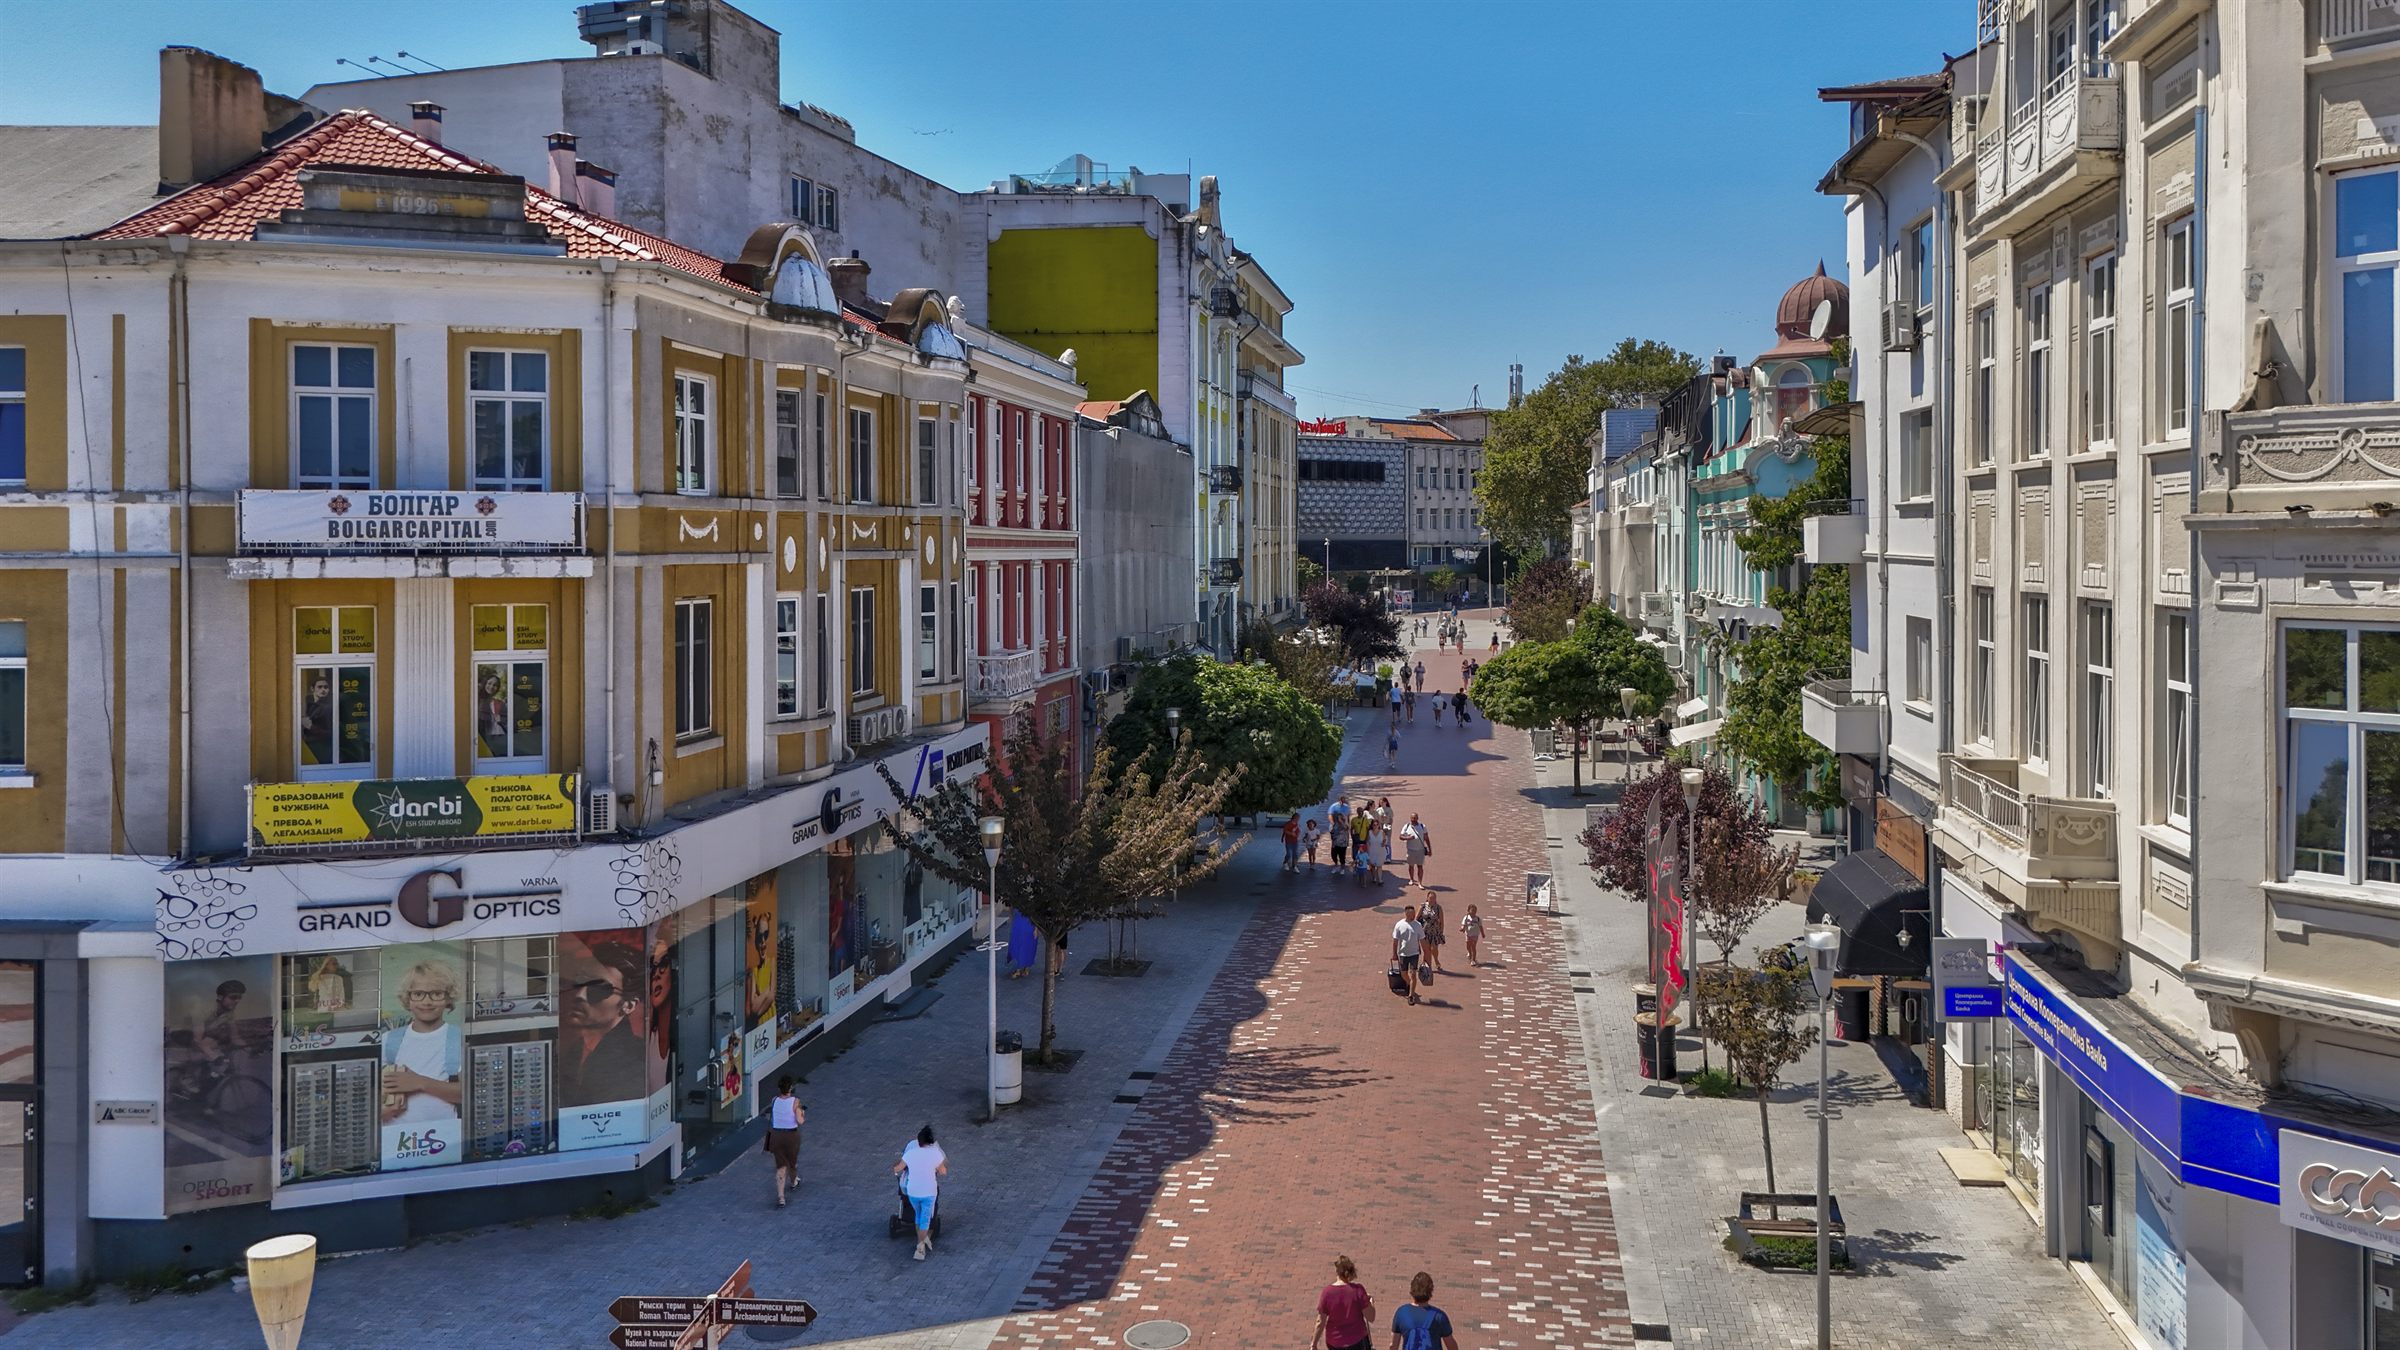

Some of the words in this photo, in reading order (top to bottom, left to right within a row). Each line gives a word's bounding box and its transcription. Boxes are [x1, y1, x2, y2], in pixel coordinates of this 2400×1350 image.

[393, 197, 439, 215] 1926
[368, 495, 459, 516] БОЛГАР
[491, 785, 532, 793] ЕЗИКОВА
[273, 792, 344, 802] ОБРАЗОВАНИЕ
[491, 794, 552, 803] ПОДГОТОВКА
[281, 804, 330, 812] ЧУЖБИНА
[389, 796, 462, 818] darbi
[273, 819, 313, 827] ПРЕВОД
[405, 820, 417, 828] ESH
[437, 818, 462, 826] ABROAD
[491, 818, 552, 828] www.darbi.eu
[273, 828, 343, 838] ЛЕГАЛИЗАЦИЯ
[792, 824, 818, 845] GRAND
[521, 877, 559, 888] VARNA
[397, 868, 469, 929] G
[299, 911, 392, 932] GRAND
[473, 899, 561, 920] OPTICS
[2008, 970, 2039, 1012] Централна
[2039, 997, 2085, 1053] Кооперативна
[2085, 1037, 2108, 1072] Банка
[2008, 996, 2022, 1017] Central
[2043, 1028, 2055, 1047] Bank
[289, 1042, 320, 1051] OPTIC
[581, 1111, 622, 1120] POLICE
[396, 1150, 428, 1159] OPTIC
[183, 1178, 228, 1194] OPTO
[197, 1183, 253, 1201] SPORT
[638, 1301, 664, 1309] Римски
[665, 1303, 687, 1311] терми
[734, 1301, 783, 1312] Археологически
[785, 1304, 805, 1314] музей
[639, 1312, 661, 1320] Roman
[662, 1312, 691, 1320] Thermae
[734, 1312, 779, 1323] Archaeological
[780, 1314, 807, 1323] Museum
[625, 1328, 642, 1338] Музей
[625, 1339, 648, 1348] National
[648, 1339, 668, 1348] Revival
